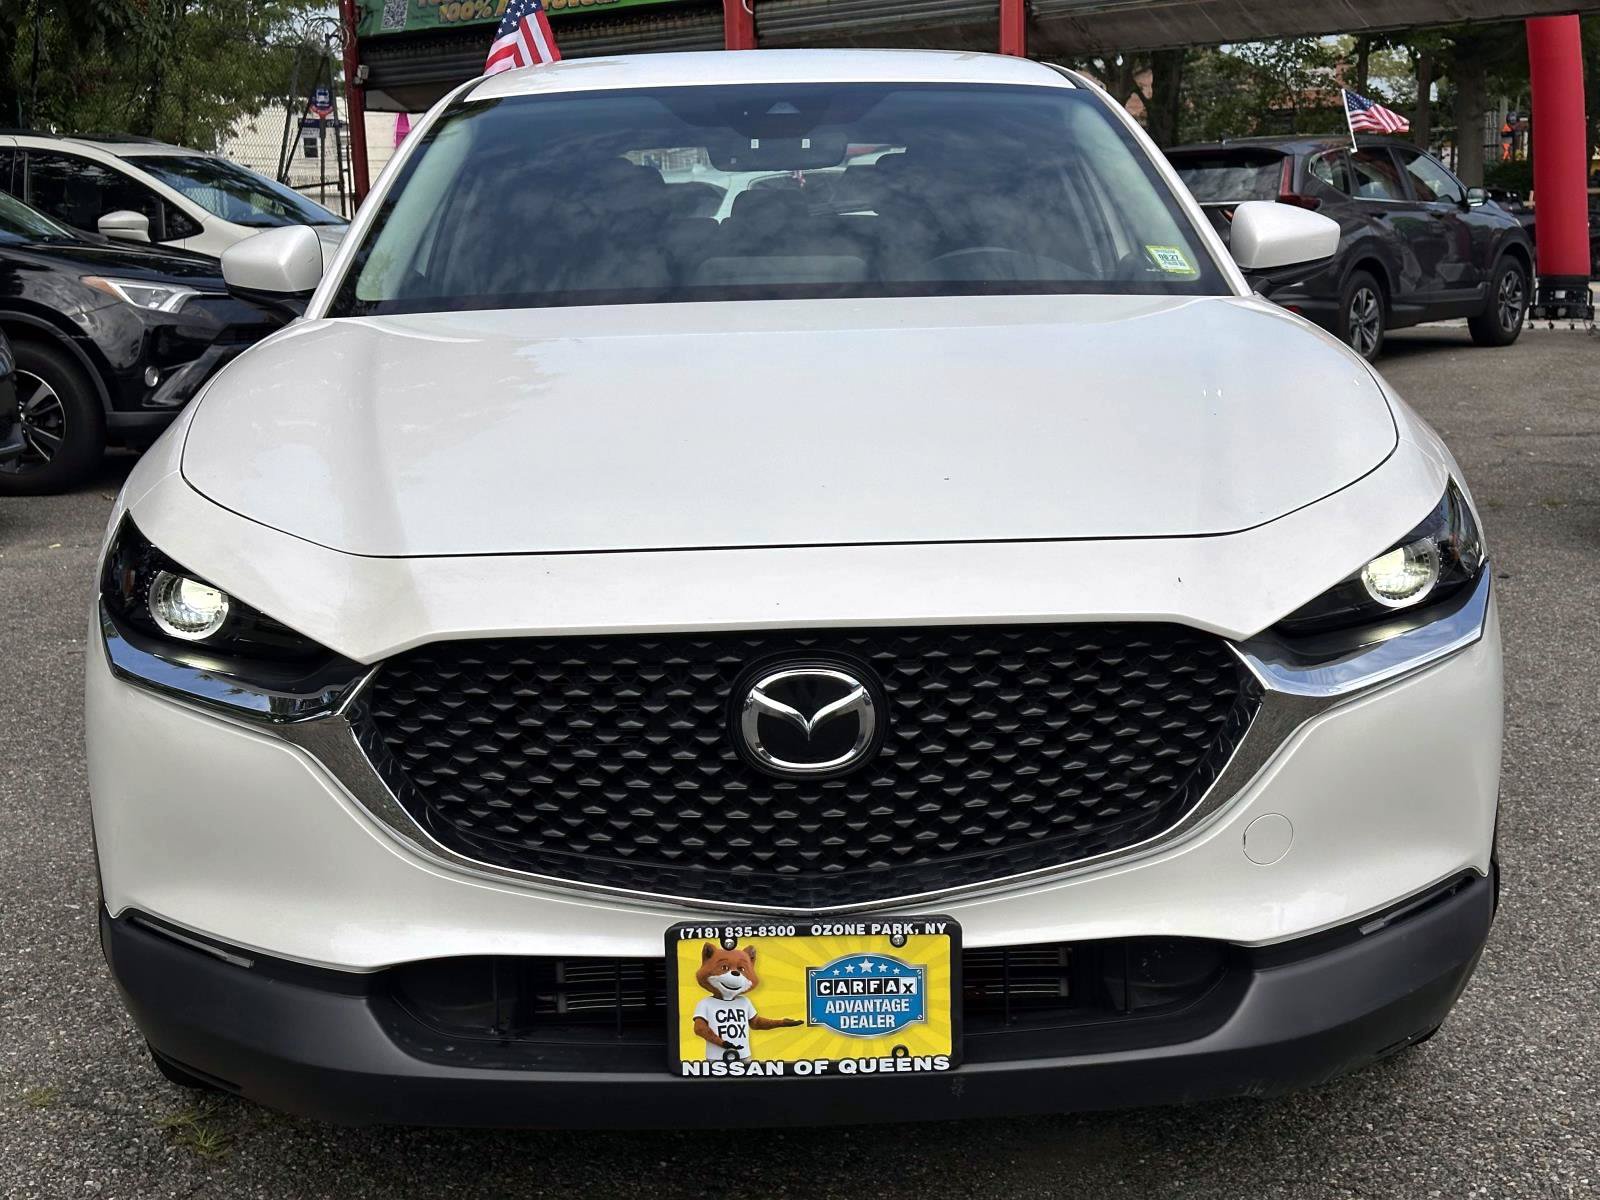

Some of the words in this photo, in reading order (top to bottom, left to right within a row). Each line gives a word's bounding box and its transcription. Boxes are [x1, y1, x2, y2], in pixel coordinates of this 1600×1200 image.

[438, 0, 493, 22] 100%
[680, 927, 720, 939] (718)
[725, 925, 796, 938] 835-8300
[811, 923, 866, 936] OZONE
[871, 922, 919, 936] PARK,
[925, 922, 947, 935] NY
[825, 998, 910, 1014] ADVANTAGE
[715, 1008, 747, 1024] CAR
[840, 1014, 896, 1029] DEALER
[717, 1023, 747, 1039] FOX
[682, 1061, 785, 1077] NISSAN
[793, 1059, 829, 1076] OF
[838, 1055, 951, 1075] QUEENS
